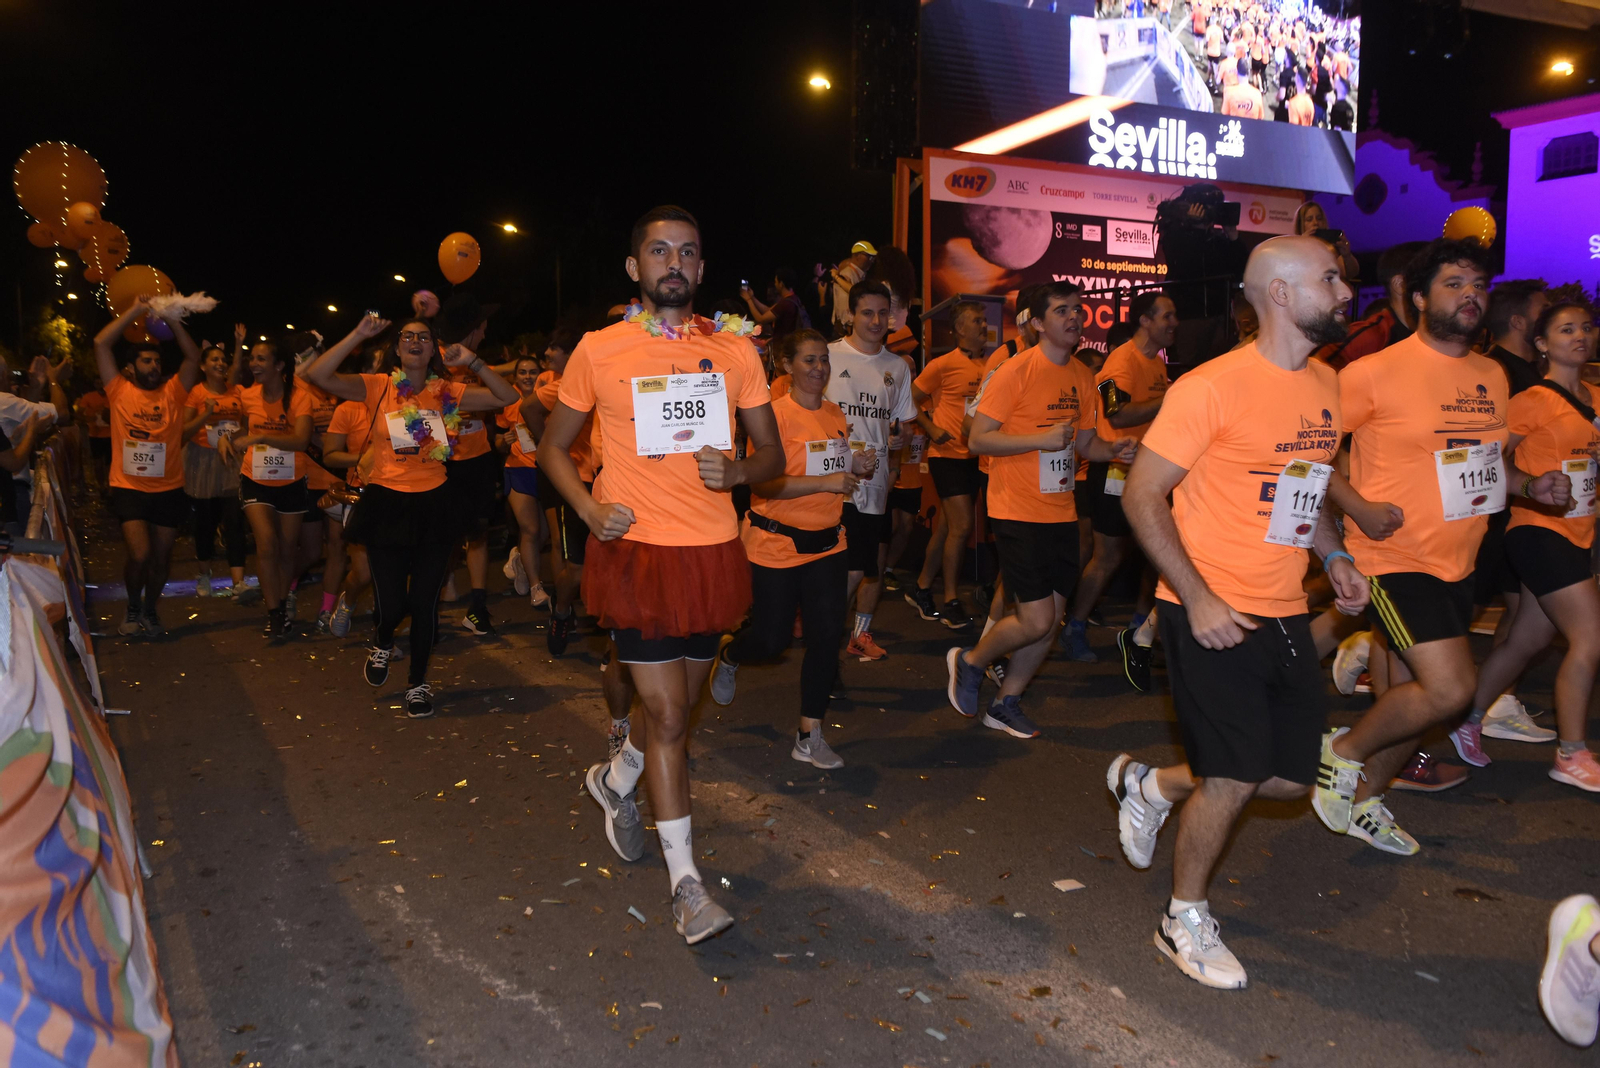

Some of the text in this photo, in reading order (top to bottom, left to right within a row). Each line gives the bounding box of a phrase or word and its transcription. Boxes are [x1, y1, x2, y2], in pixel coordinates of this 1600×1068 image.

[1007, 179, 1029, 191] ABC
[1040, 185, 1085, 200] Cruzcampo
[1092, 192, 1138, 203] TORRE SEVILLA
[1081, 258, 1093, 269] 30
[1093, 259, 1106, 270] de
[1106, 261, 1157, 274] septiembre
[859, 392, 877, 405] Fly
[1456, 398, 1494, 406] NOCTURNA
[662, 400, 706, 420] 5588
[838, 401, 891, 420] Emirates
[1047, 403, 1069, 411] SEVILLA
[1440, 404, 1476, 413] SEVILLA
[1297, 430, 1337, 439] NOCTURNA
[1274, 440, 1316, 452] SEVILLA
[133, 452, 155, 463] 5574
[263, 456, 284, 465] 5852
[823, 455, 845, 471] 9743
[1459, 466, 1498, 489] 11146
